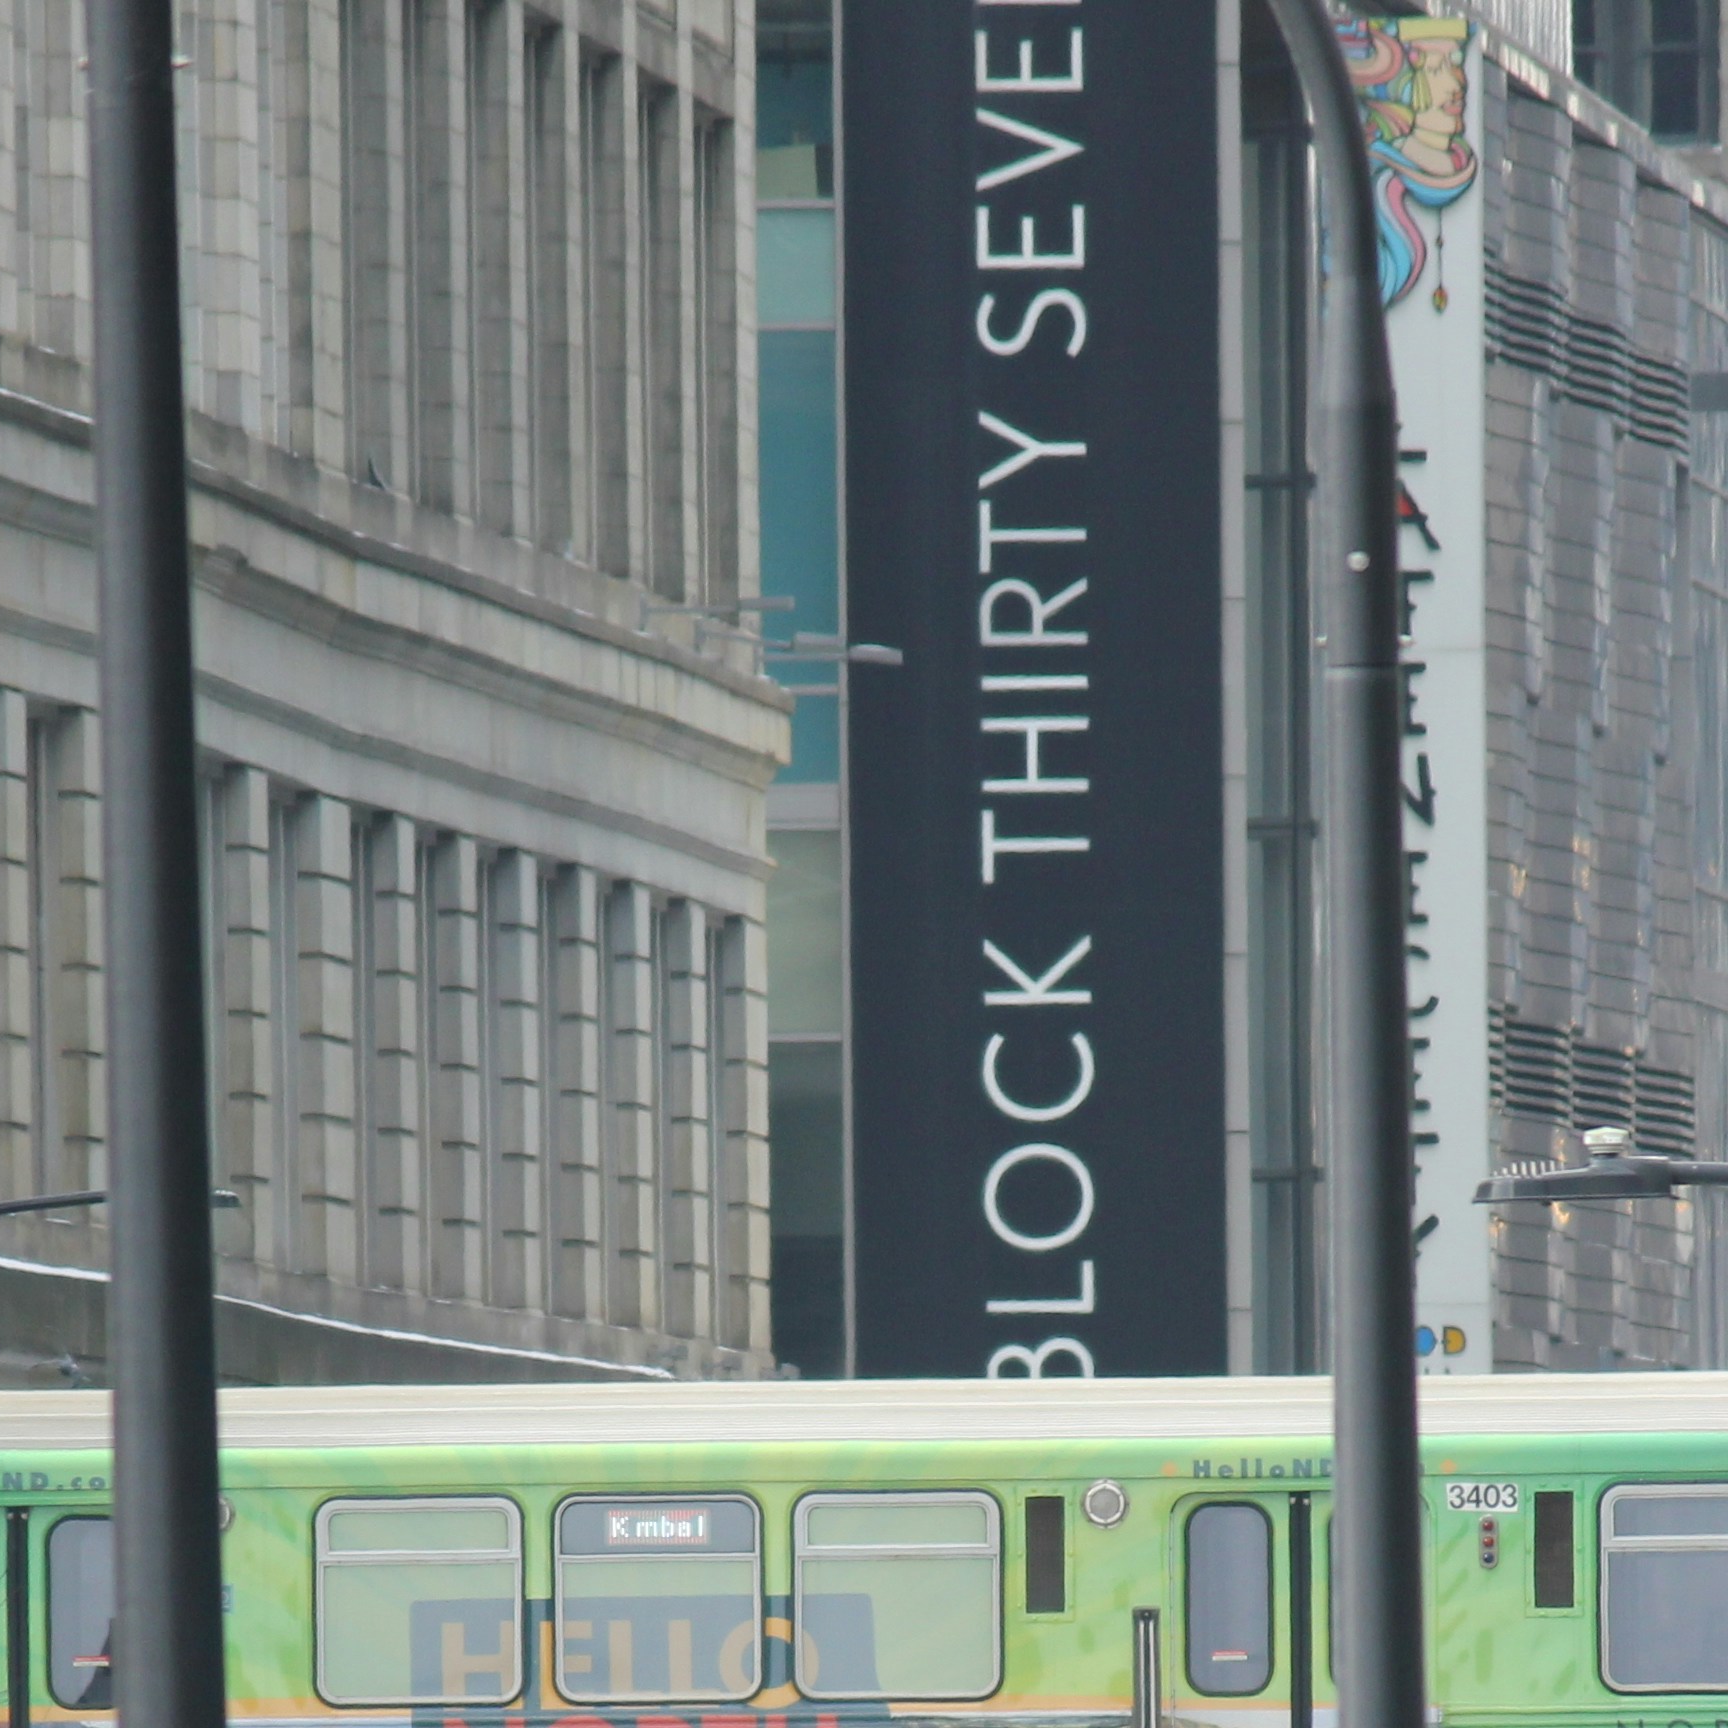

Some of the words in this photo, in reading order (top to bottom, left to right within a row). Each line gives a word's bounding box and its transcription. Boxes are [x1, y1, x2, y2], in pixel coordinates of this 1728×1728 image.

[978, 411, 1091, 884] THIRTY
[983, 934, 1095, 1377] BLOCK
[1448, 1484, 1518, 1509] 3403
[441, 1617, 819, 1710] HELLO
